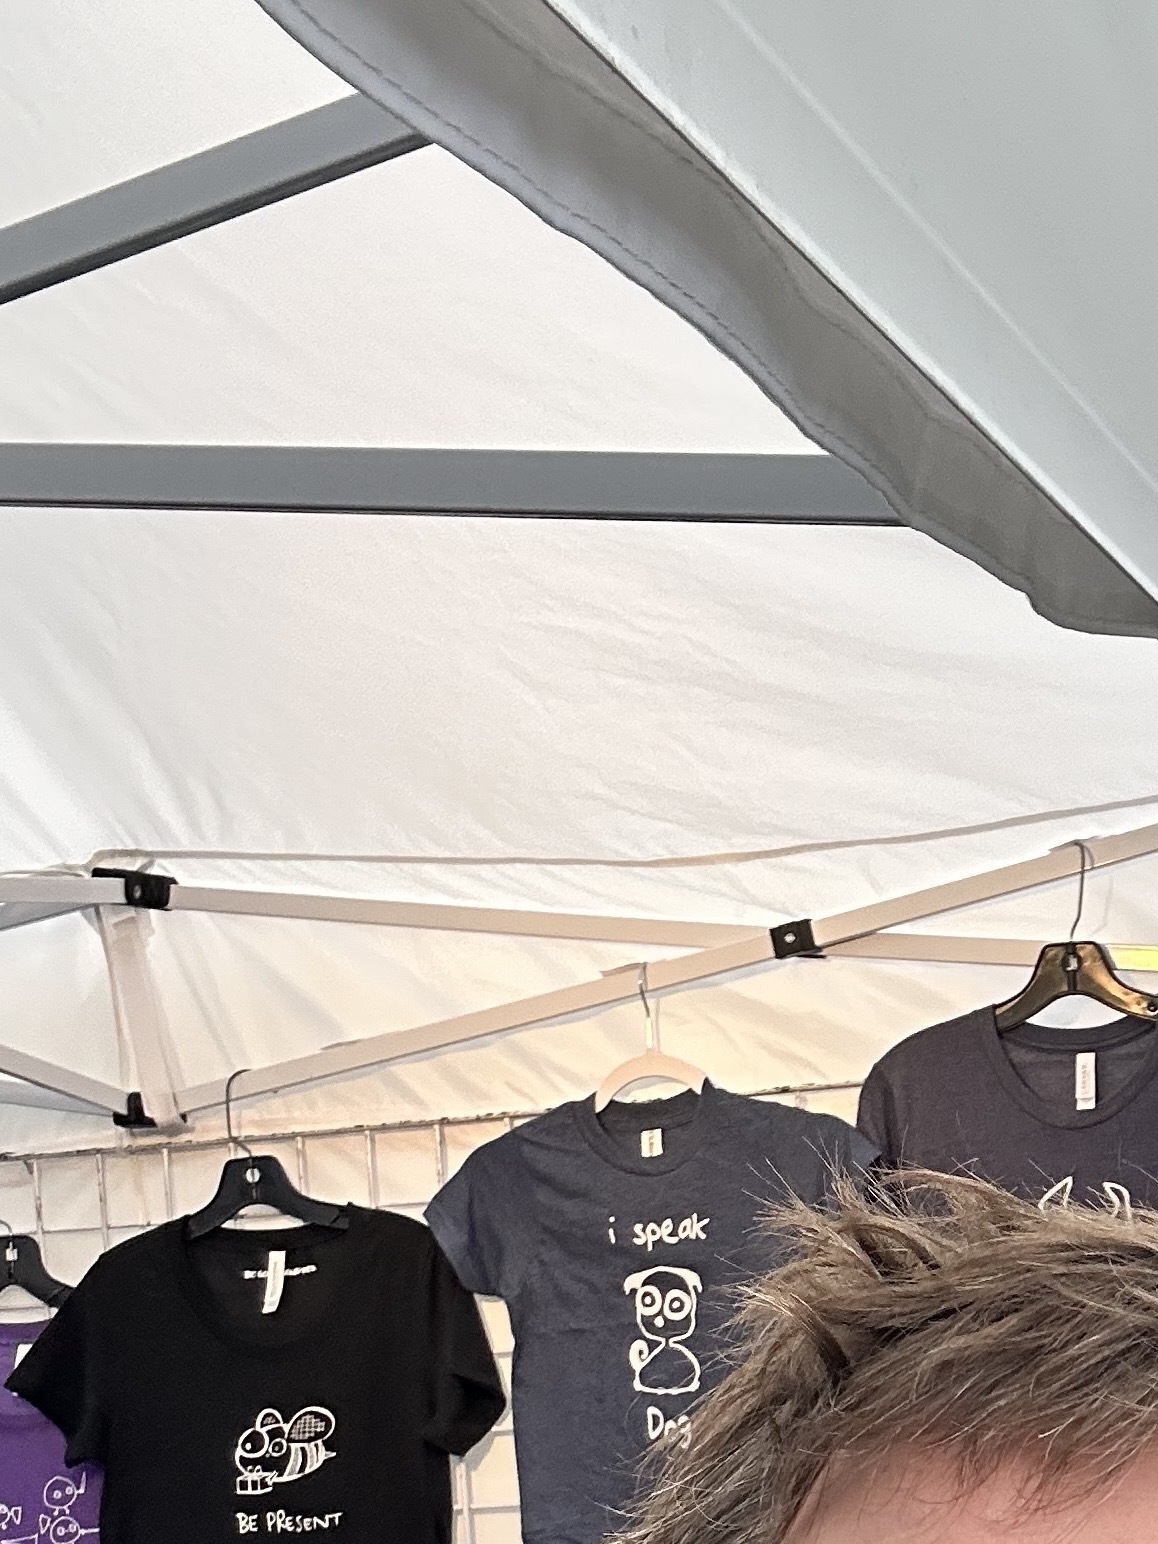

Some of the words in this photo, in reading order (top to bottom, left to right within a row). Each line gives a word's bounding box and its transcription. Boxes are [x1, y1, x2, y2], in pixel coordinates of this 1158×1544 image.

[608, 1215, 616, 1245] i
[632, 1212, 710, 1252] speak
[236, 1512, 258, 1534] BE
[266, 1509, 343, 1534] PRESENT
